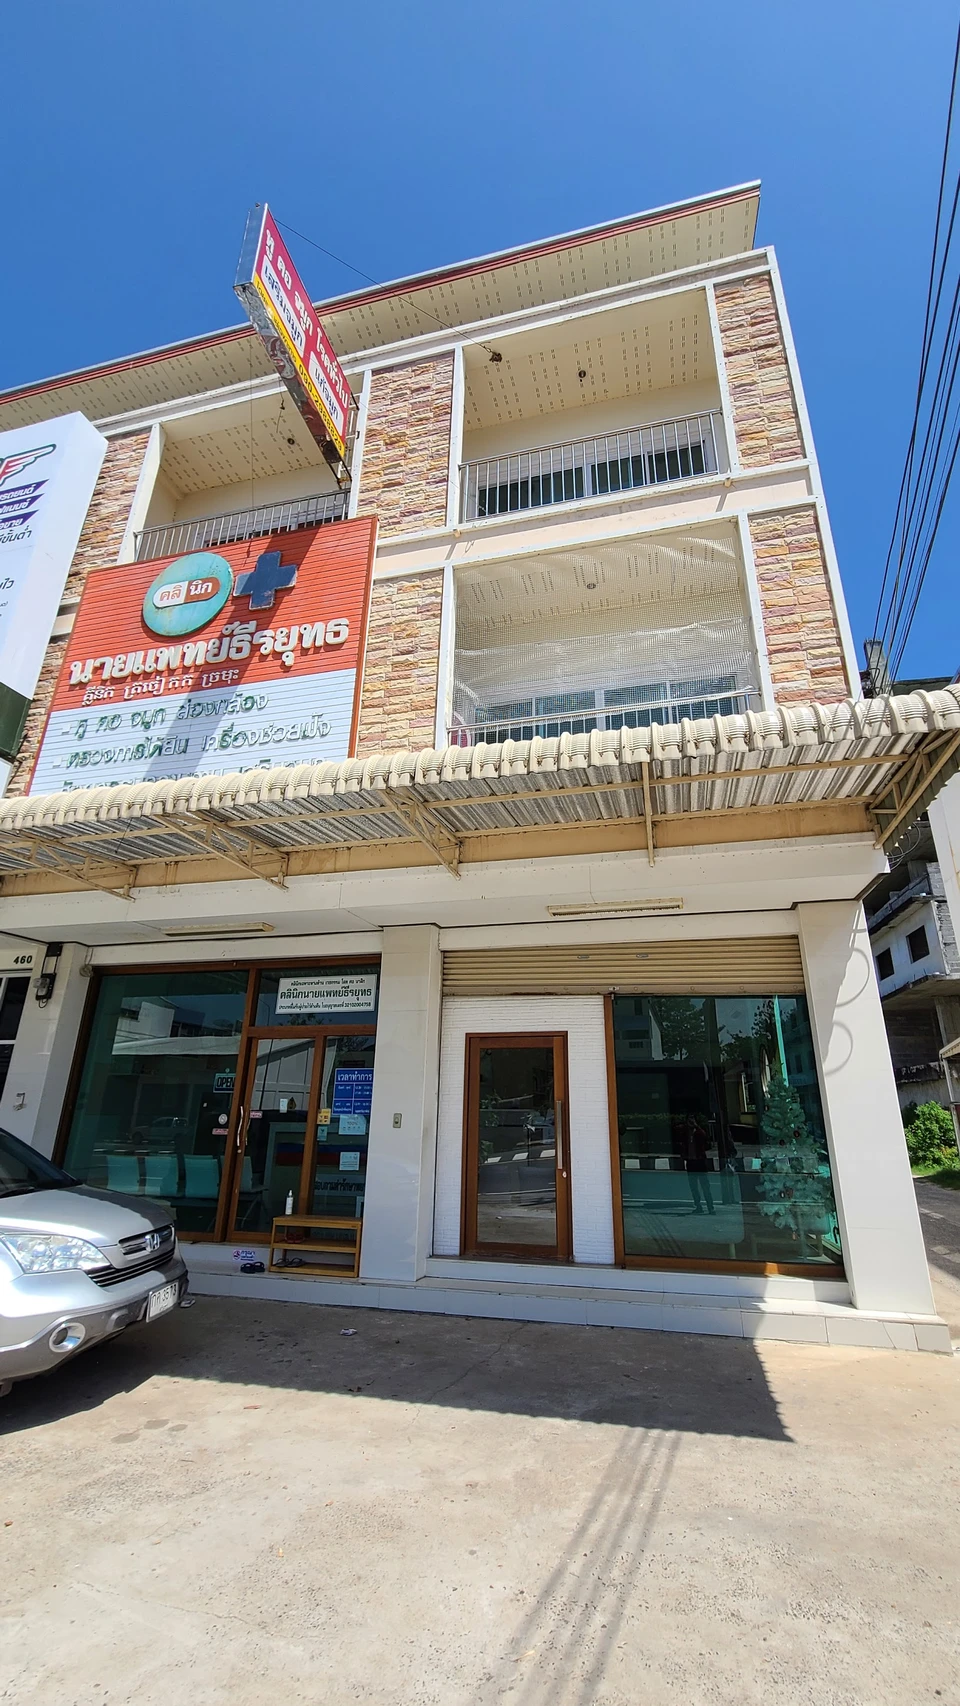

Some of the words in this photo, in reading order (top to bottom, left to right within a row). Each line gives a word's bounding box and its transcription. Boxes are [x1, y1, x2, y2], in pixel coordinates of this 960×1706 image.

[264, 265, 303, 347] เสริมจมูก
[314, 366, 339, 421] แก้จมูก
[294, 291, 314, 337] จมูก
[316, 327, 349, 409] โรคทั่วไป
[0, 484, 37, 501] รถยนต์
[69, 618, 349, 684] นายแพทย์ธีรยุทธ
[130, 707, 166, 732] จมูก
[13, 955, 33, 965] 460
[280, 985, 373, 1001] คลินิกนายแพทย์ธีรยุทธ
[337, 1070, 373, 1081] เวลาทำการ
